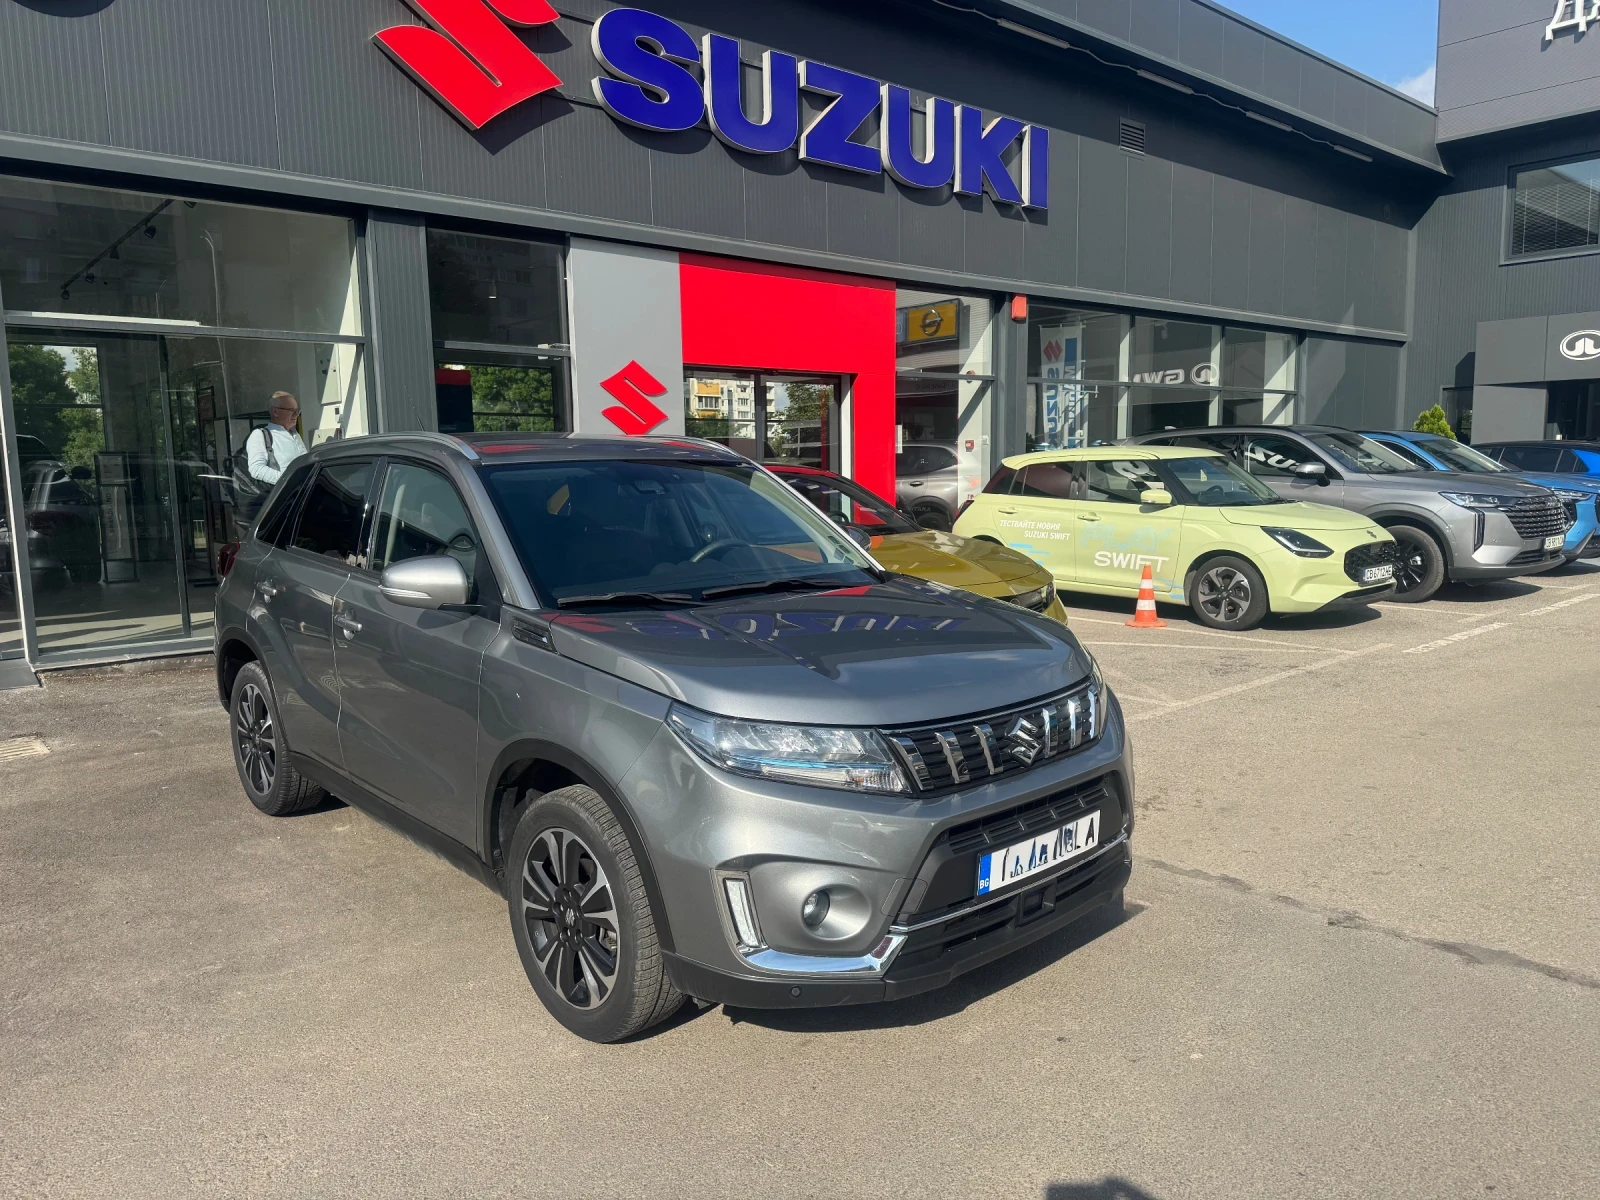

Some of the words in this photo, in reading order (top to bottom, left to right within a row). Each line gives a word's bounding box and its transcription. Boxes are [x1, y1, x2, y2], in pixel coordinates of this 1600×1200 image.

[591, 7, 1049, 210] SUZUKI
[1000, 519, 1036, 530] ТЕСТВАЙТЕ
[1037, 522, 1060, 531] НОВИЯ
[1024, 530, 1049, 539] SUZUKI
[1050, 533, 1070, 541] SWIFT
[1080, 523, 1174, 552] PLAY
[1094, 551, 1169, 573] SWIFT
[979, 878, 990, 889] BG
